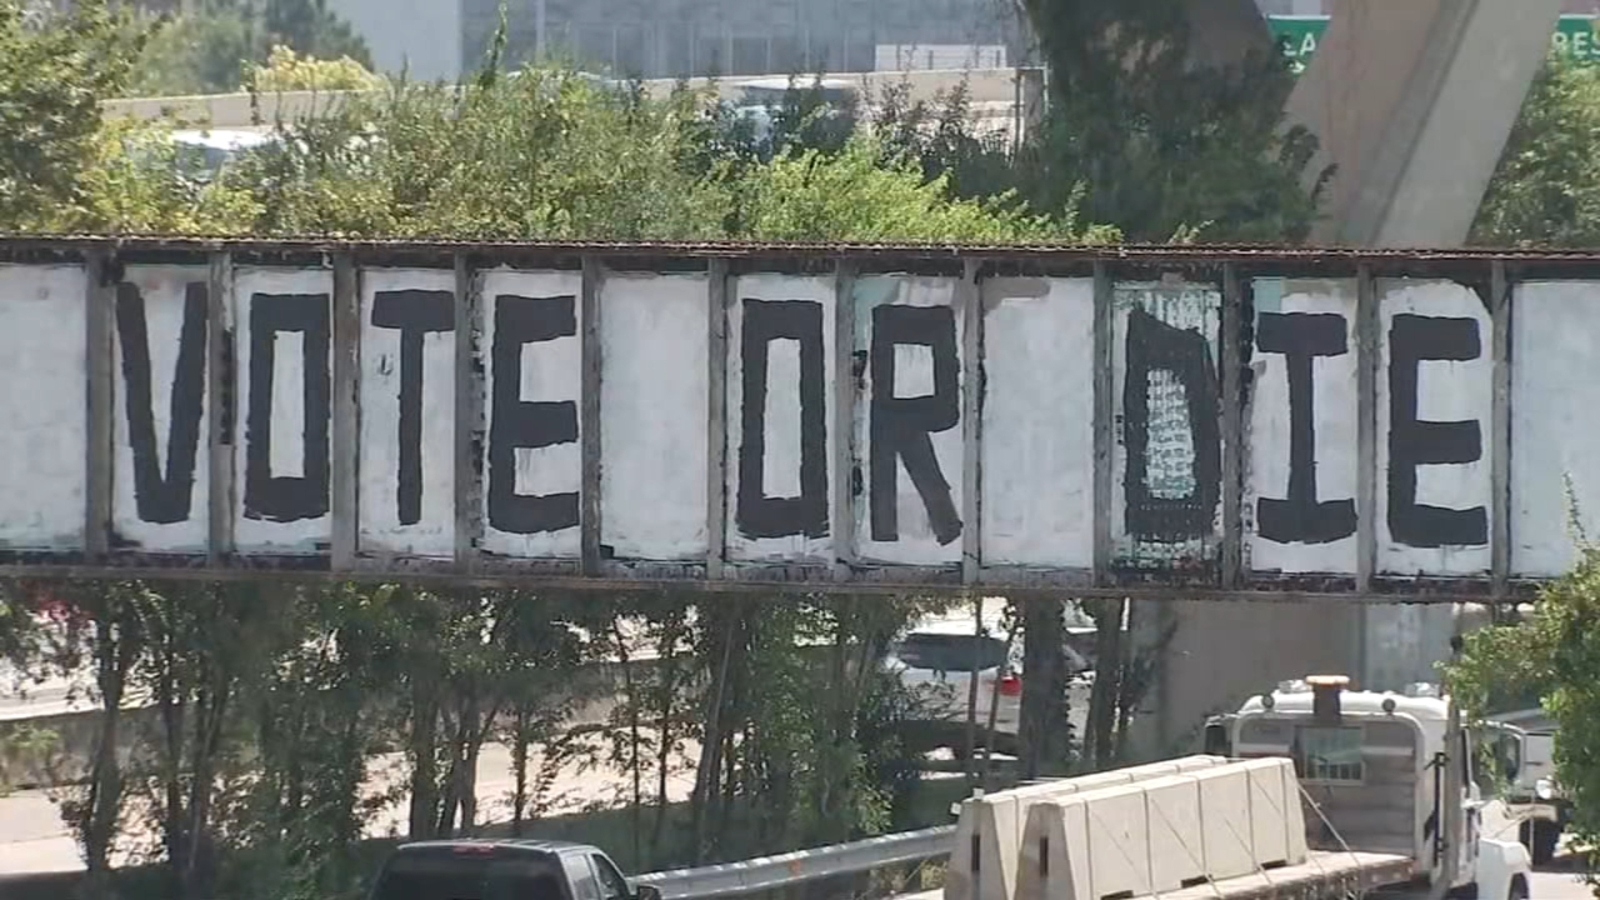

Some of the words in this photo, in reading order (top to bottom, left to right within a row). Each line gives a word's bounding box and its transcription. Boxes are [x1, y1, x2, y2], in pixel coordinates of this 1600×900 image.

[116, 281, 580, 533] VOTE
[737, 298, 963, 545] OR
[1124, 308, 1488, 547] DIE
